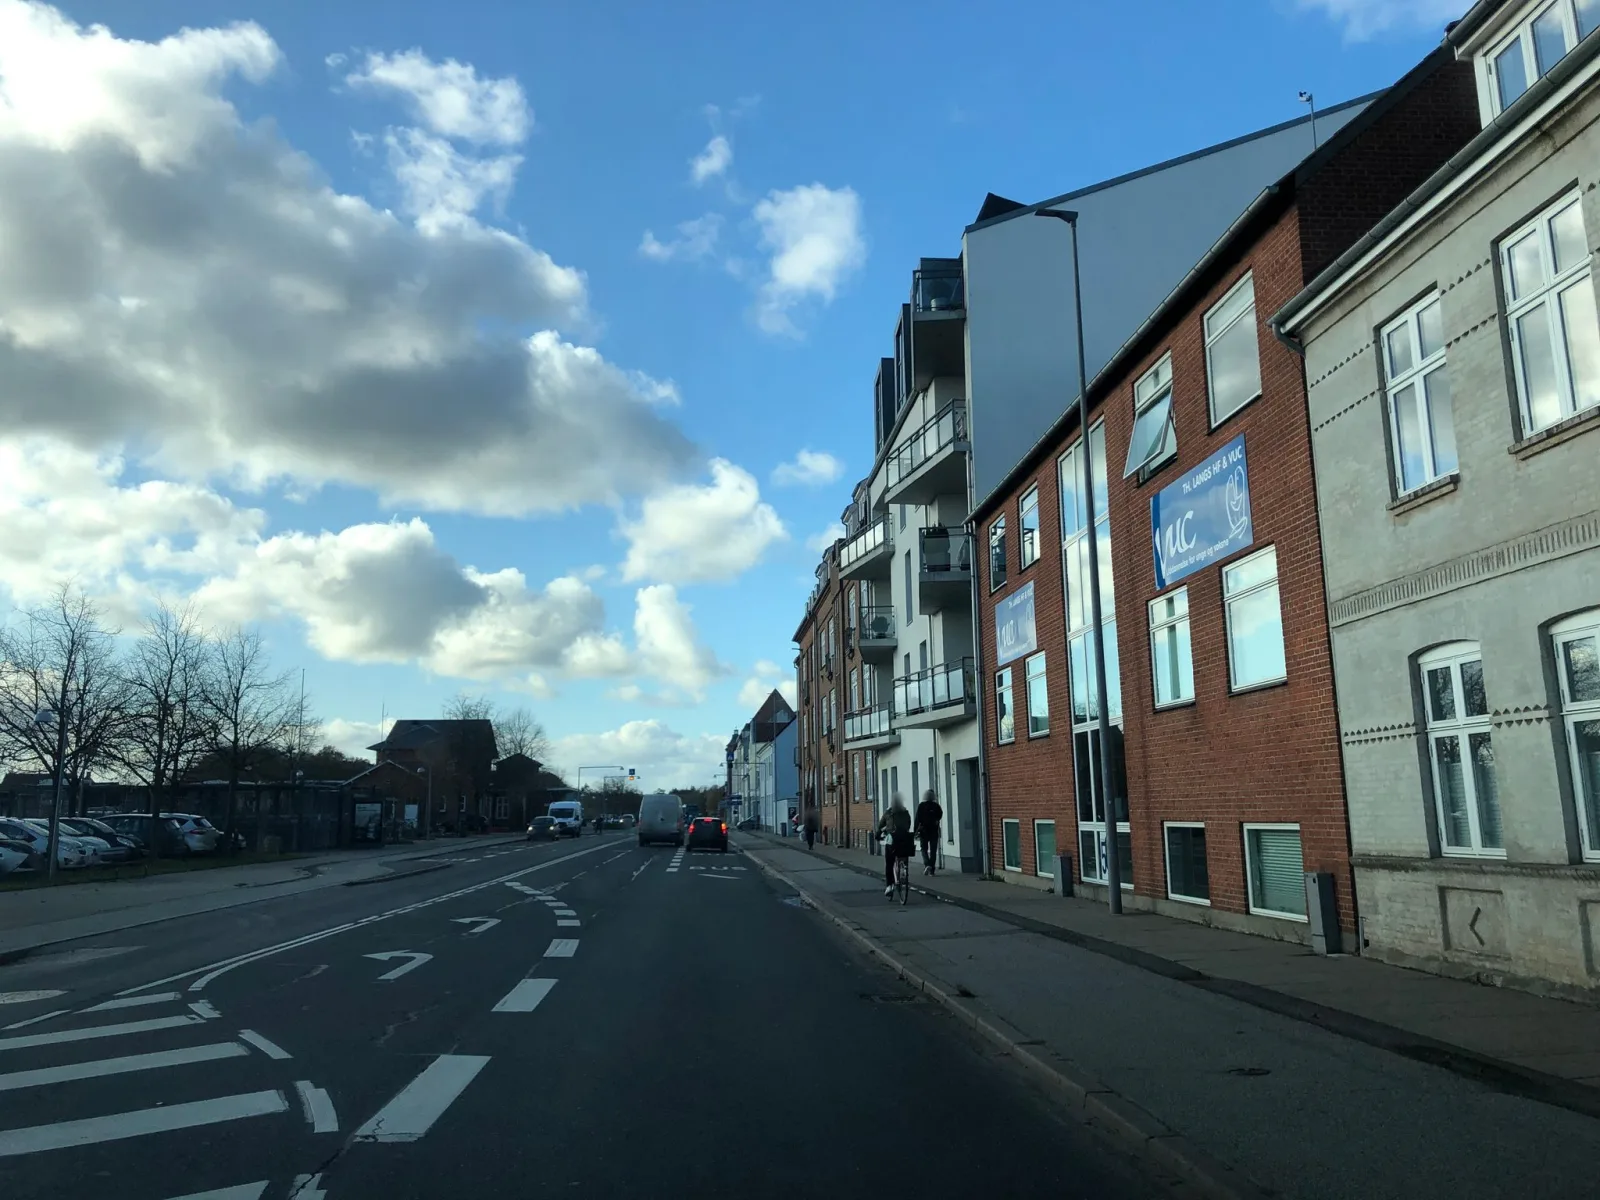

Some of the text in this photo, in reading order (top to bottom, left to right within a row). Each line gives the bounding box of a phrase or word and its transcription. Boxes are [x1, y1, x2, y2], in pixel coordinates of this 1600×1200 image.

[1182, 445, 1242, 495] TH. LANGS HF & VUC
[1154, 510, 1197, 579] VUC
